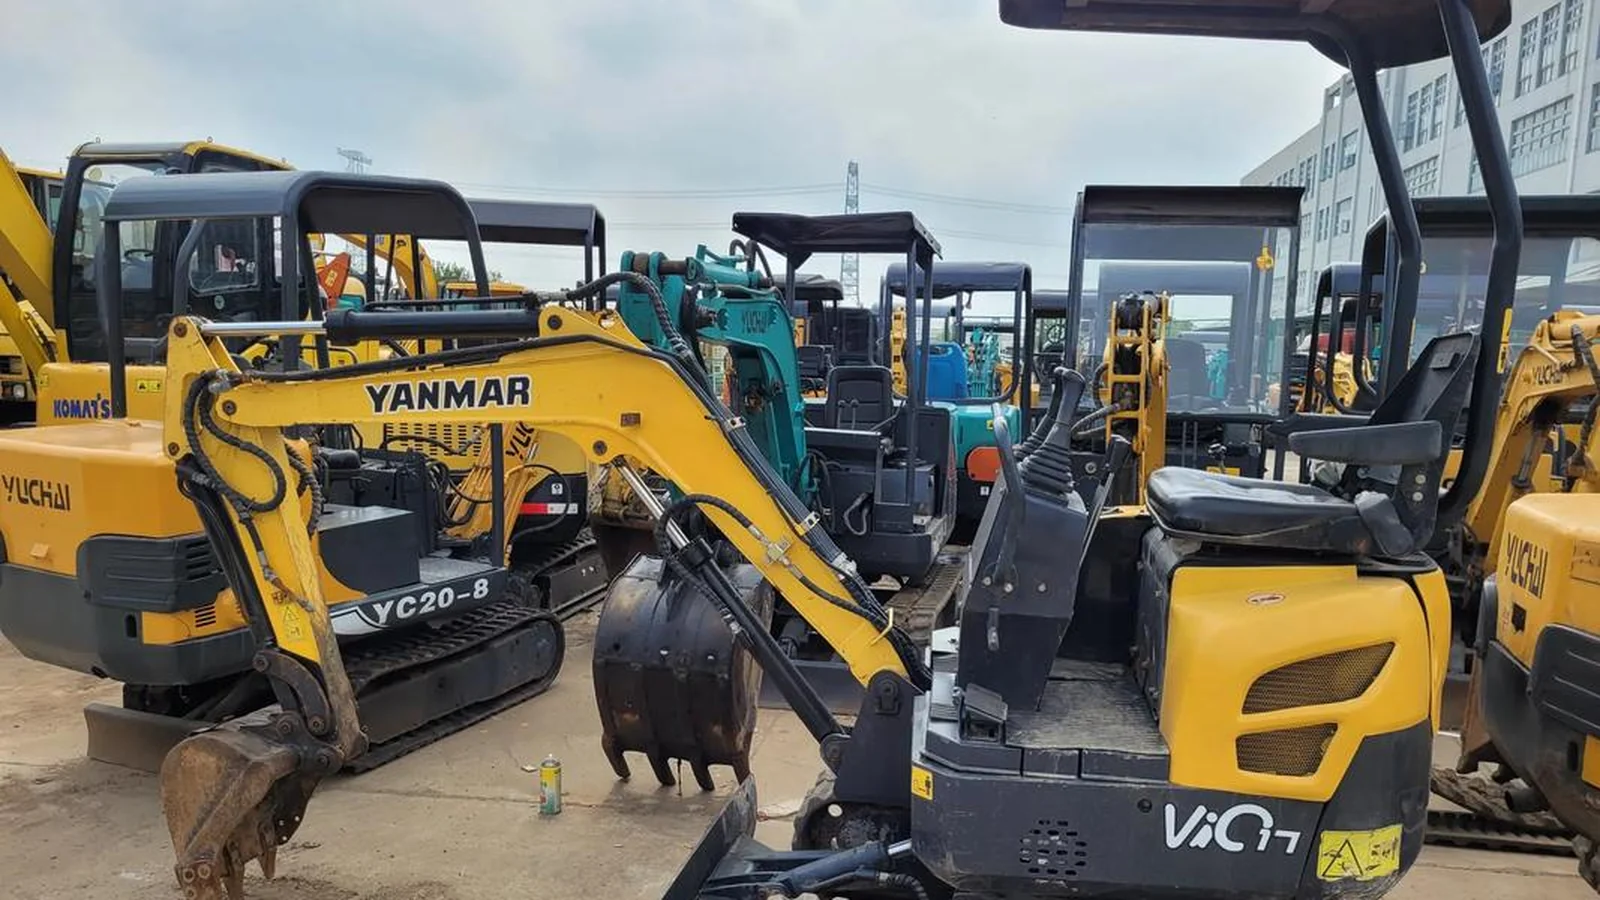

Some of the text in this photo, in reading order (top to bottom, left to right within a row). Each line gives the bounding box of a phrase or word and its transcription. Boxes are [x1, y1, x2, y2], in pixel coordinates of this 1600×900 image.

[53, 393, 112, 419] KOMATS
[365, 374, 531, 415] YANMAR
[2, 474, 71, 512] YUCHAI
[1505, 531, 1548, 600] YUCHAI
[372, 578, 489, 625] YC20-8
